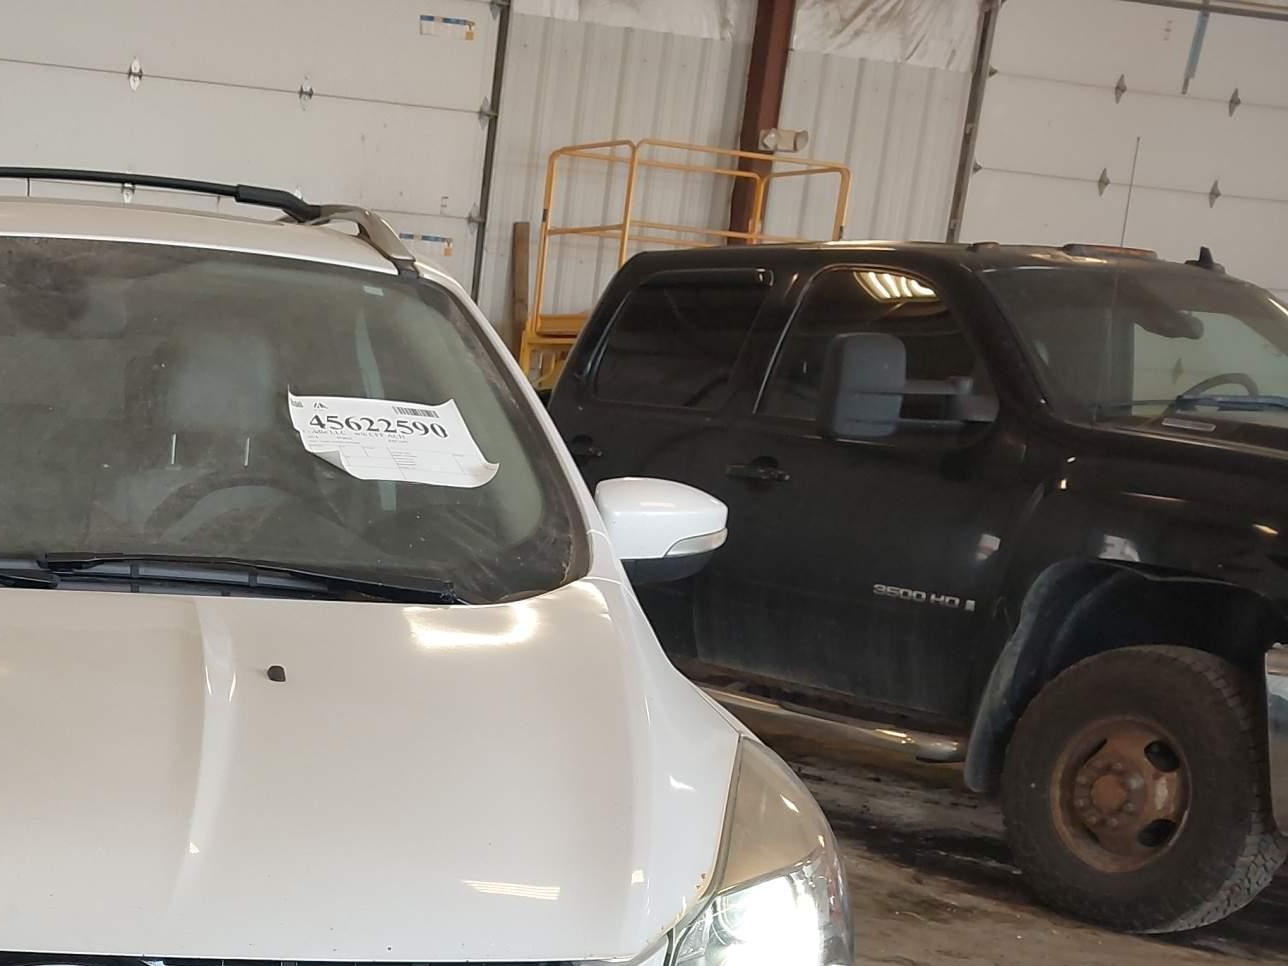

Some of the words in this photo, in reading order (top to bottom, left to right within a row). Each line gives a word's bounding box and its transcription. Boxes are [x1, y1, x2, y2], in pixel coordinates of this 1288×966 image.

[309, 414, 449, 439] 45622590
[872, 583, 927, 603] 3500
[930, 593, 960, 608] HD
